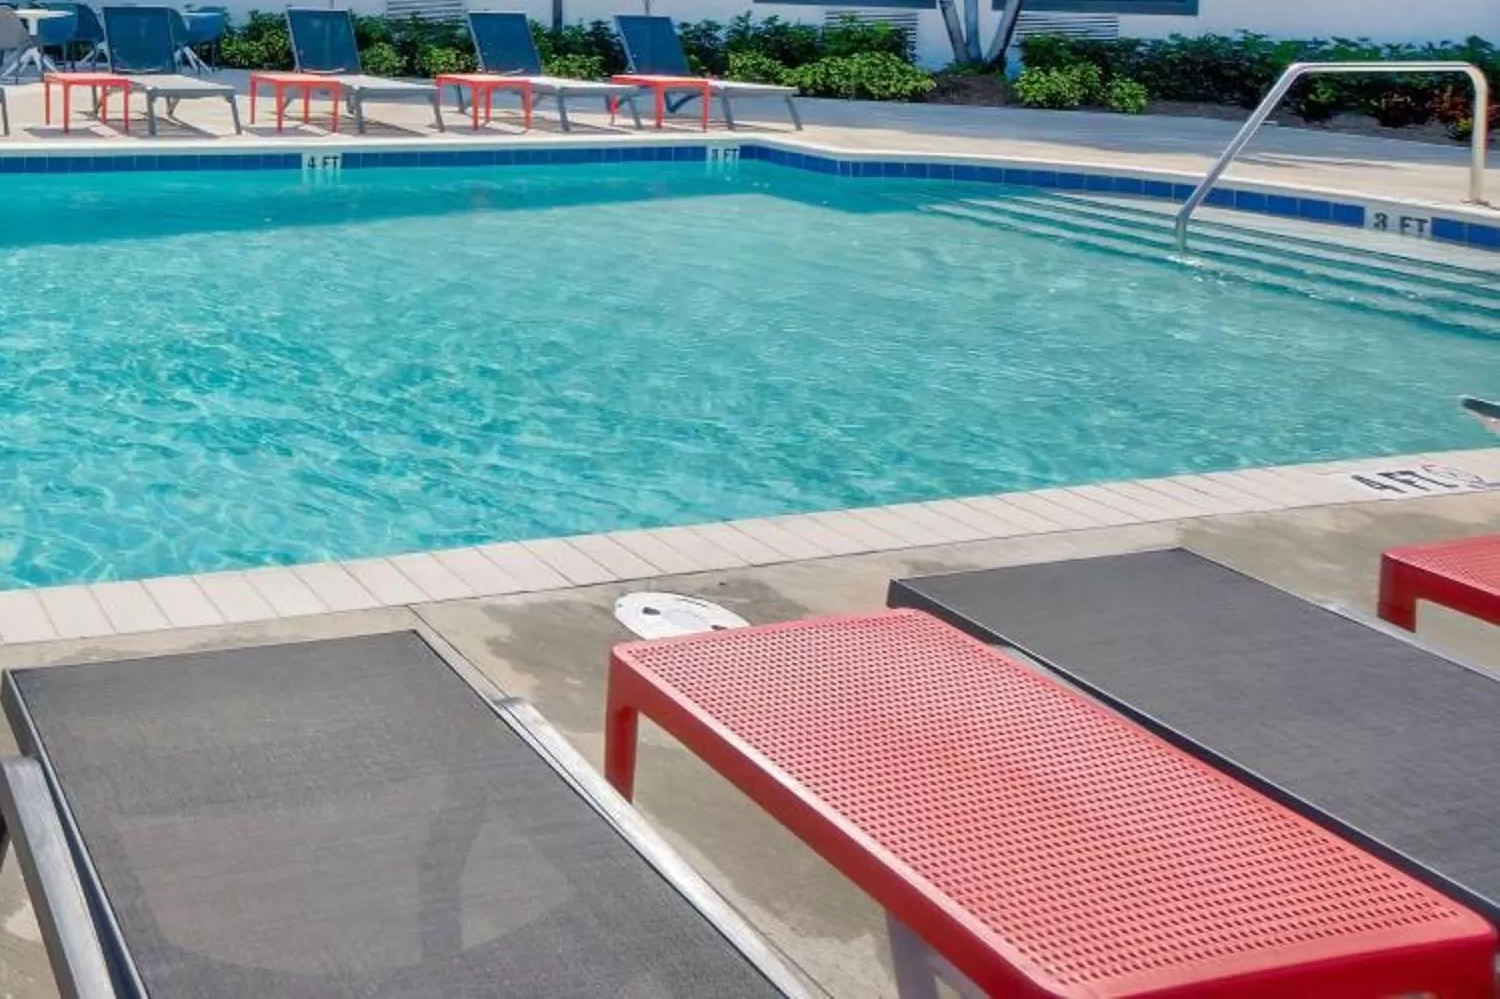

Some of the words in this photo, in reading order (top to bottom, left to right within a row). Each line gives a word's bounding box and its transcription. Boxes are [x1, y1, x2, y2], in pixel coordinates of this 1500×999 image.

[307, 156, 316, 169] 4
[323, 155, 340, 169] FT
[1400, 216, 1429, 234] FT
